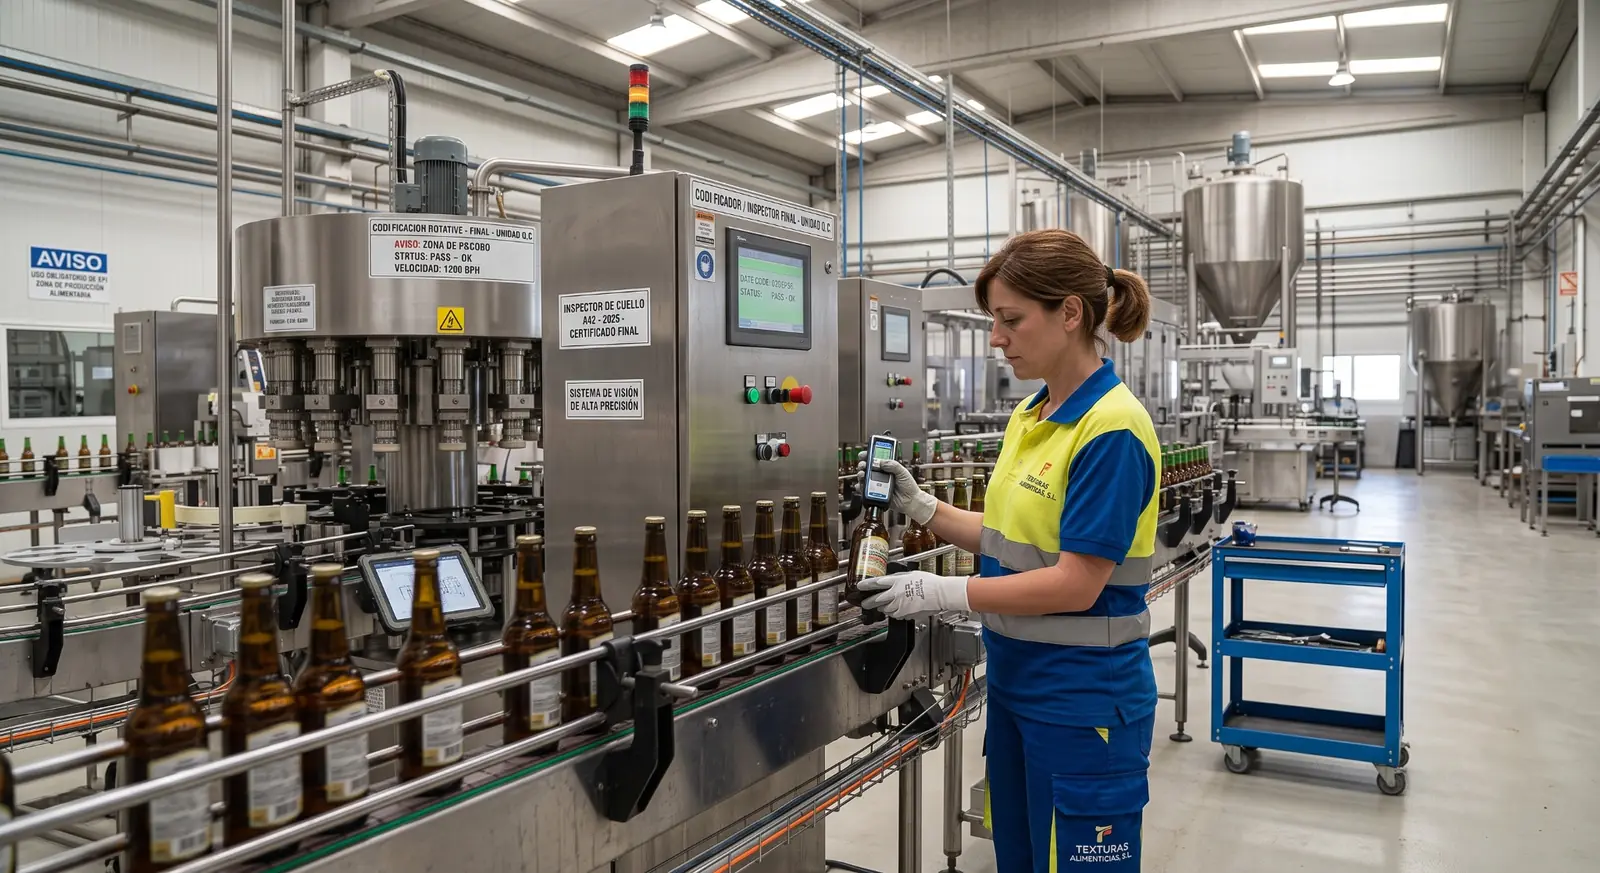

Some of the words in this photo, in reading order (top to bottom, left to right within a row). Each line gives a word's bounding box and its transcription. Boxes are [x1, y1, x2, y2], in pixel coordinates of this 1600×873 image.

[747, 201, 780, 220] INSPECTOR
[781, 210, 796, 225] FINAL
[801, 215, 820, 230] UNIDAD
[428, 224, 463, 235] ROTATIVE
[469, 226, 490, 236] FINAL
[496, 229, 521, 239] UNIDAD
[394, 240, 421, 249] AVISO:
[422, 240, 445, 250] ZONA
[446, 241, 457, 250] DE
[36, 250, 103, 271] AVISO
[430, 252, 451, 262] PASS
[461, 253, 473, 263] OK
[394, 263, 441, 273] VELOCIDAD:
[443, 264, 463, 274] 1200
[464, 265, 480, 275] BPH
[36, 280, 53, 288] ZONA
[88, 275, 97, 283] DE
[740, 274, 755, 284] DATE
[740, 287, 763, 298] STATUS:
[771, 291, 785, 302] PASS
[788, 294, 796, 303] OK
[563, 301, 603, 314] INSPECTOR
[604, 300, 615, 311] DE
[616, 299, 645, 310] CUELLO
[582, 315, 597, 325] A42
[603, 313, 620, 324] 2025
[569, 326, 616, 338] CERTIFICADO
[617, 326, 639, 336] FINAL
[569, 388, 601, 398] SISTEMA
[602, 388, 613, 398] DE
[614, 385, 639, 398] VISIÓN
[570, 401, 580, 411] DE
[581, 401, 599, 411] ALTA
[600, 398, 639, 411] PRECISIÓN
[1075, 842, 1129, 854] TEXTURAS
